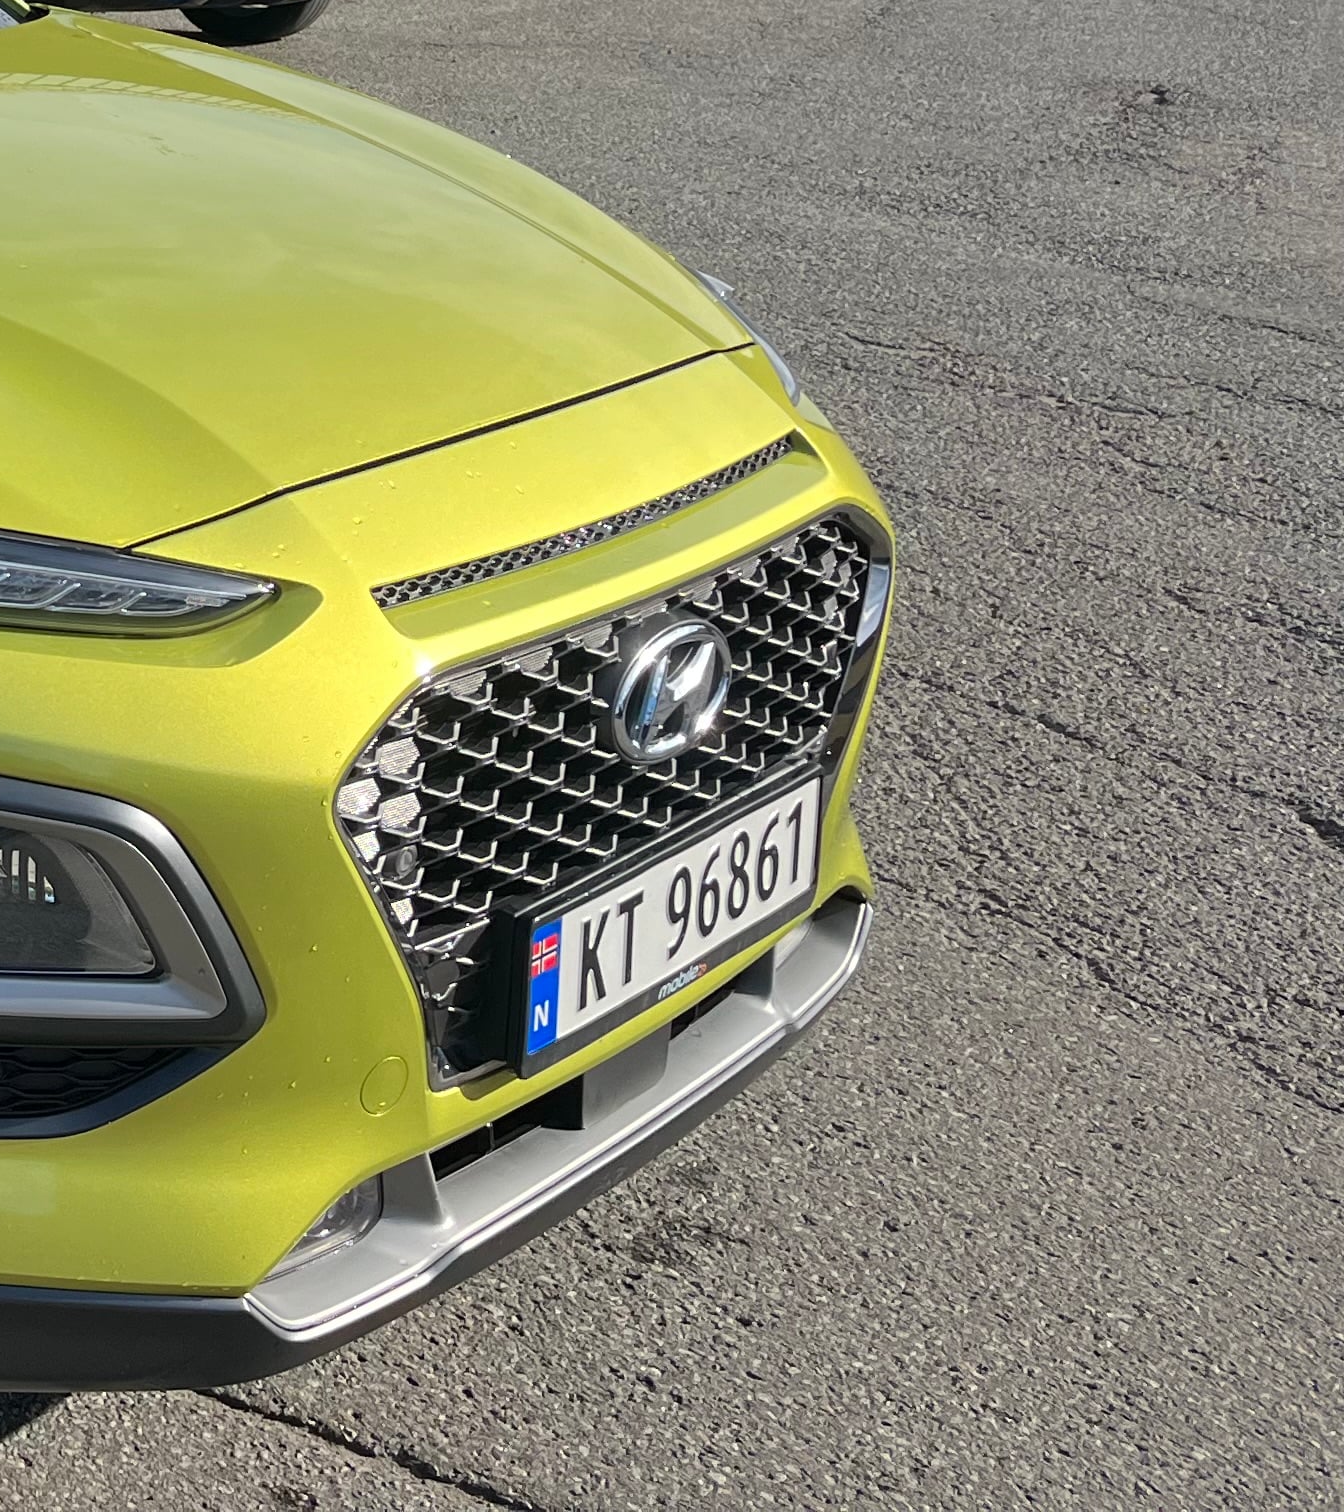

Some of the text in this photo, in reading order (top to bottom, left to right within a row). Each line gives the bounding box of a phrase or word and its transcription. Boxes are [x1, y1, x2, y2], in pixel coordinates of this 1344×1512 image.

[577, 798, 804, 1011] KT 96861
[532, 999, 550, 1032] N
